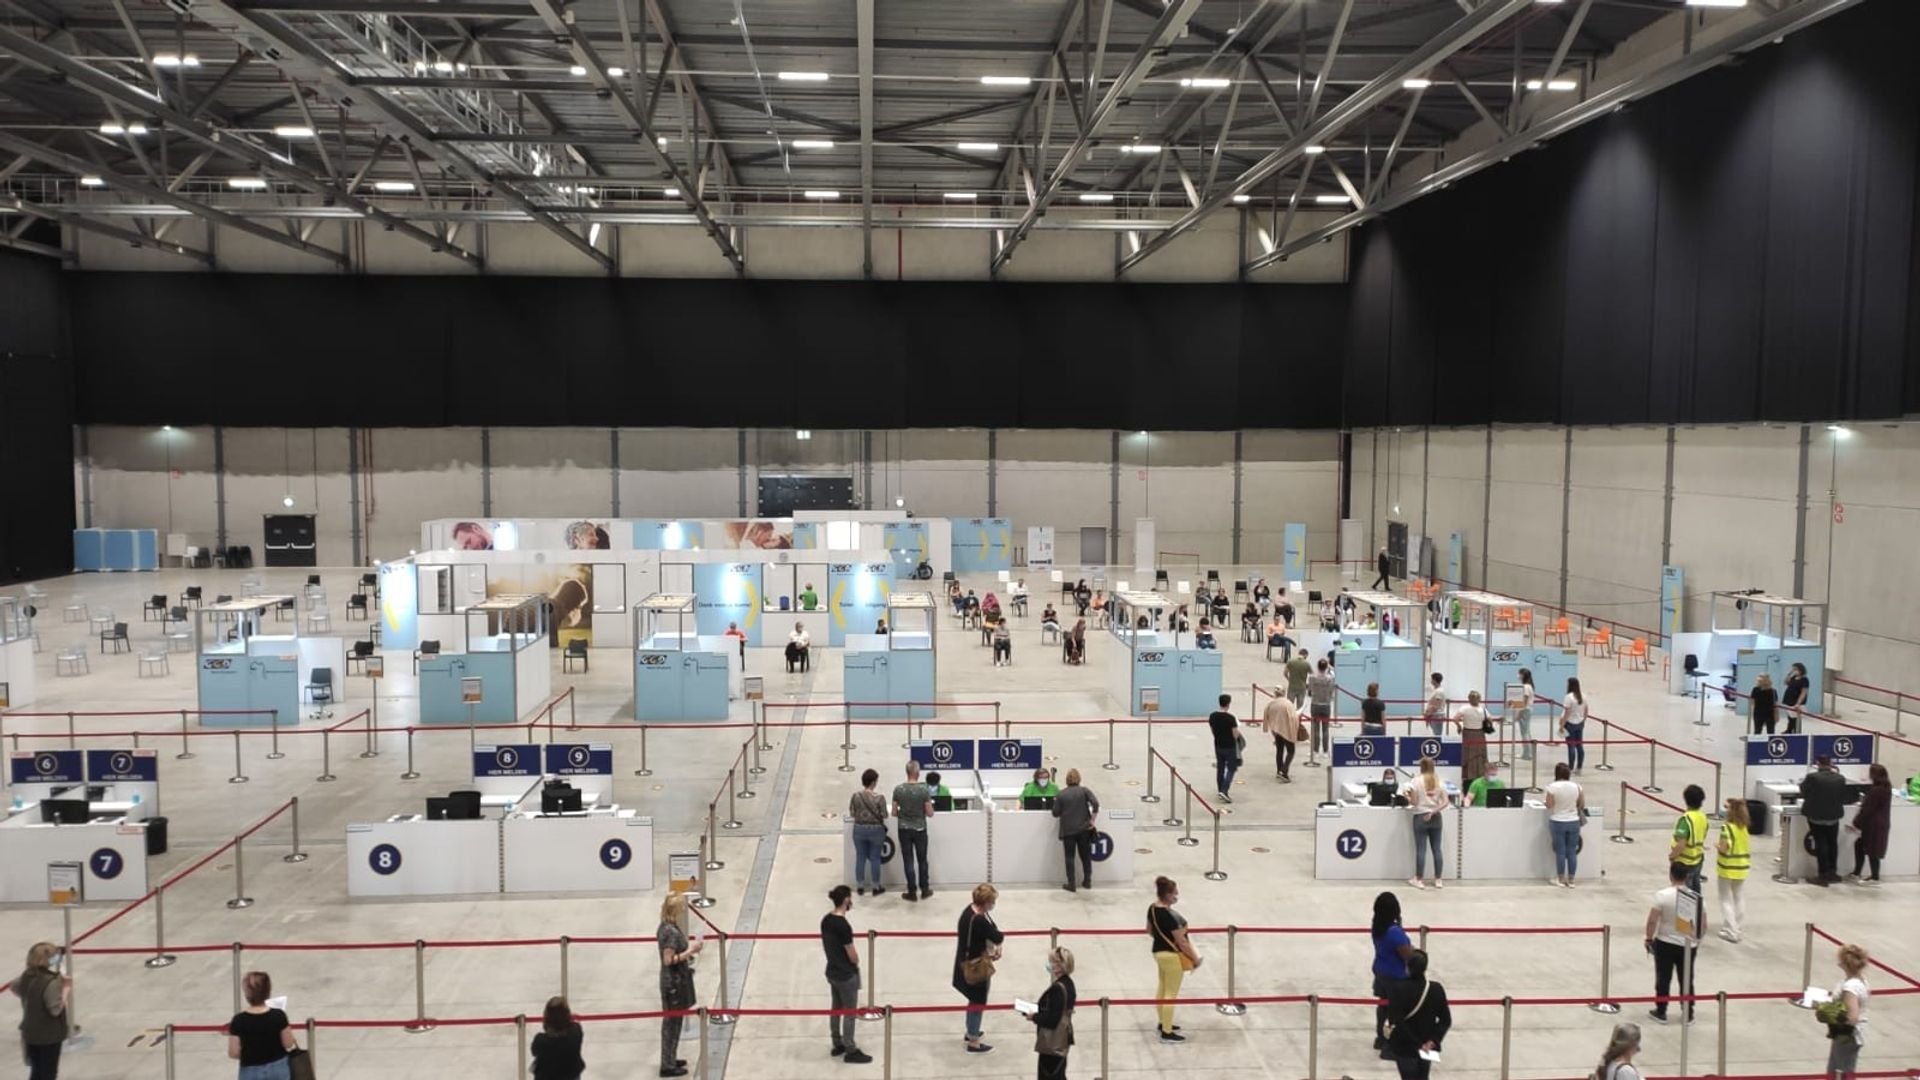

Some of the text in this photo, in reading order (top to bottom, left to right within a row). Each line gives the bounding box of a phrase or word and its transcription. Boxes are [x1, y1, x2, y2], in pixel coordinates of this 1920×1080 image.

[936, 747, 949, 757] 10
[1004, 746, 1016, 756] 11
[1358, 744, 1370, 754] 12
[1425, 744, 1437, 754] 13
[1772, 743, 1784, 752] 14
[1837, 742, 1849, 752] 15
[503, 752, 512, 763] 8
[574, 751, 583, 762] 9
[42, 758, 51, 769] 6
[117, 757, 126, 768] 7
[1341, 837, 1362, 852] 12
[379, 851, 392, 868] 8
[609, 846, 622, 862] 9
[99, 856, 113, 872] 7
